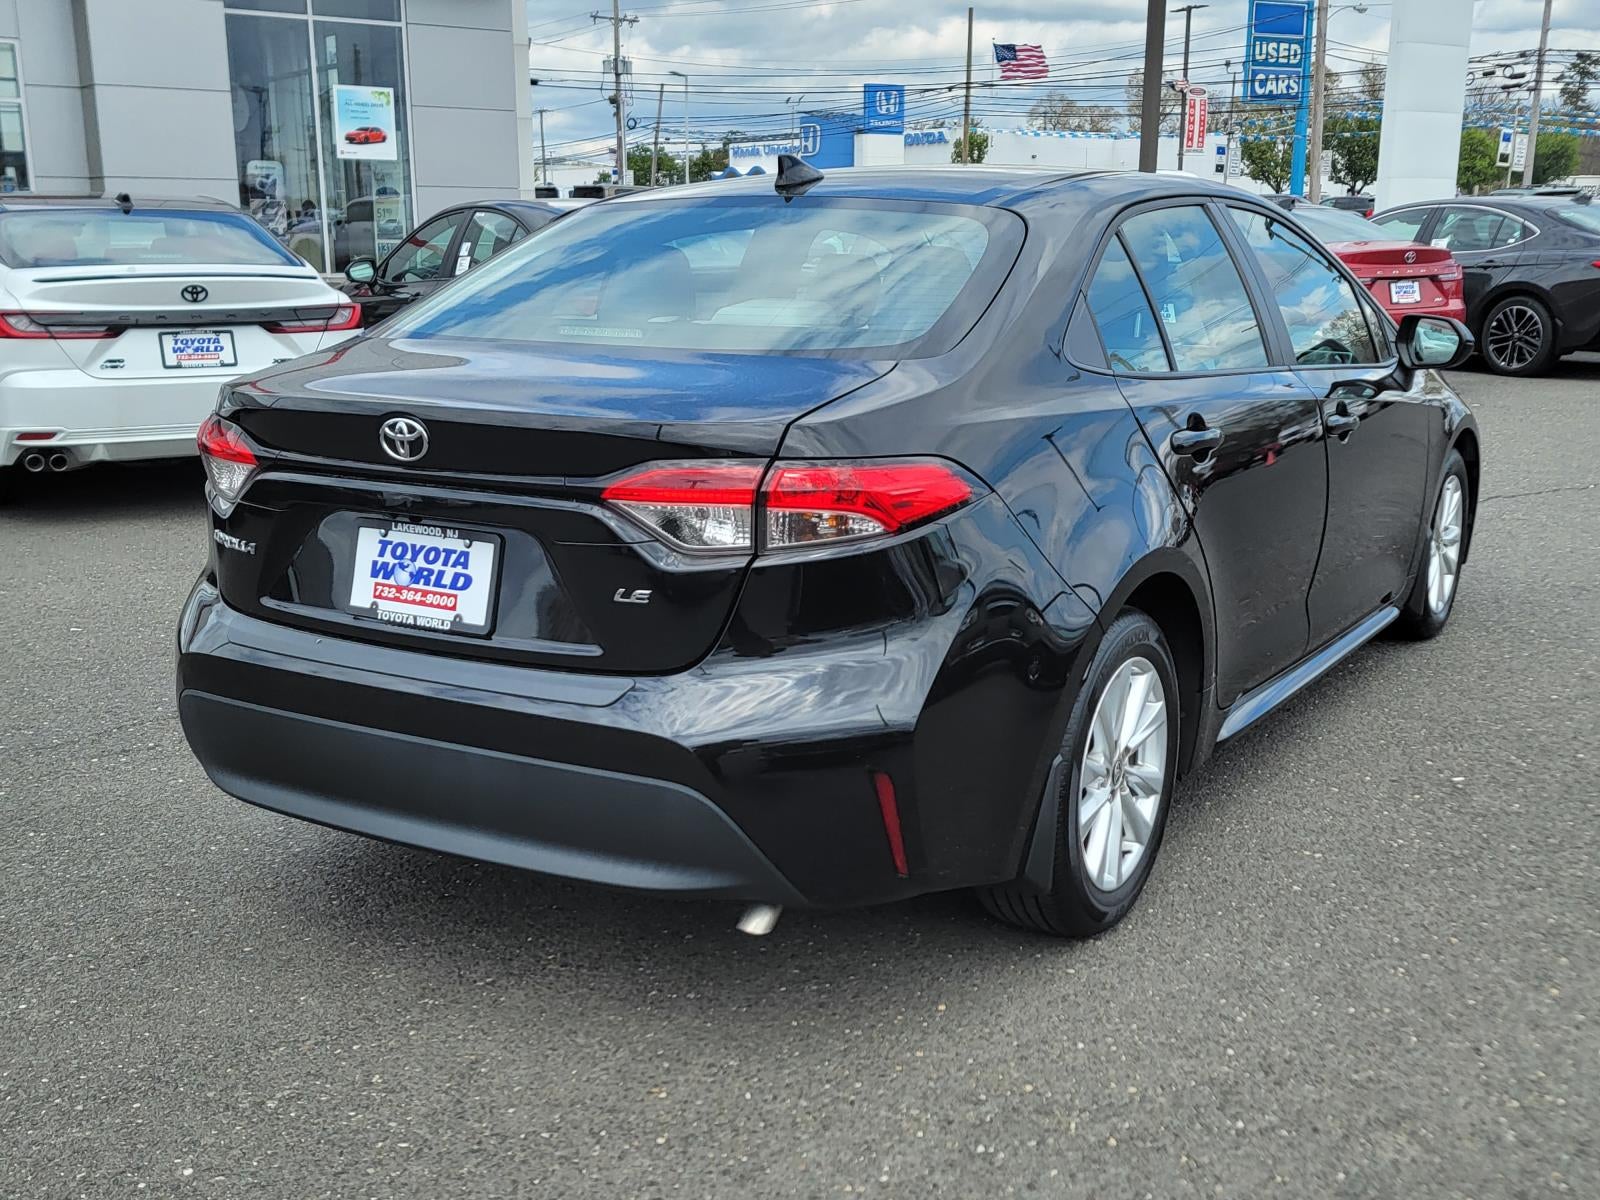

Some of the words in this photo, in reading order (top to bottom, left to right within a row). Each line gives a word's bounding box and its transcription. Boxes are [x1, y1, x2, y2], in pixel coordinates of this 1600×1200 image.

[1254, 41, 1301, 64] USED
[1254, 73, 1299, 95] CARS
[904, 131, 949, 145] ONDA
[172, 337, 221, 346] TOYOTA
[391, 522, 445, 538] LAKEWOOD,
[446, 530, 459, 539] NJ
[377, 539, 470, 570] TOYOTA
[370, 560, 473, 591] WORLD
[374, 585, 455, 607] 732-364-9000
[613, 588, 653, 604] LE
[376, 610, 414, 625] TOYOTA
[416, 615, 451, 630] WORLD
